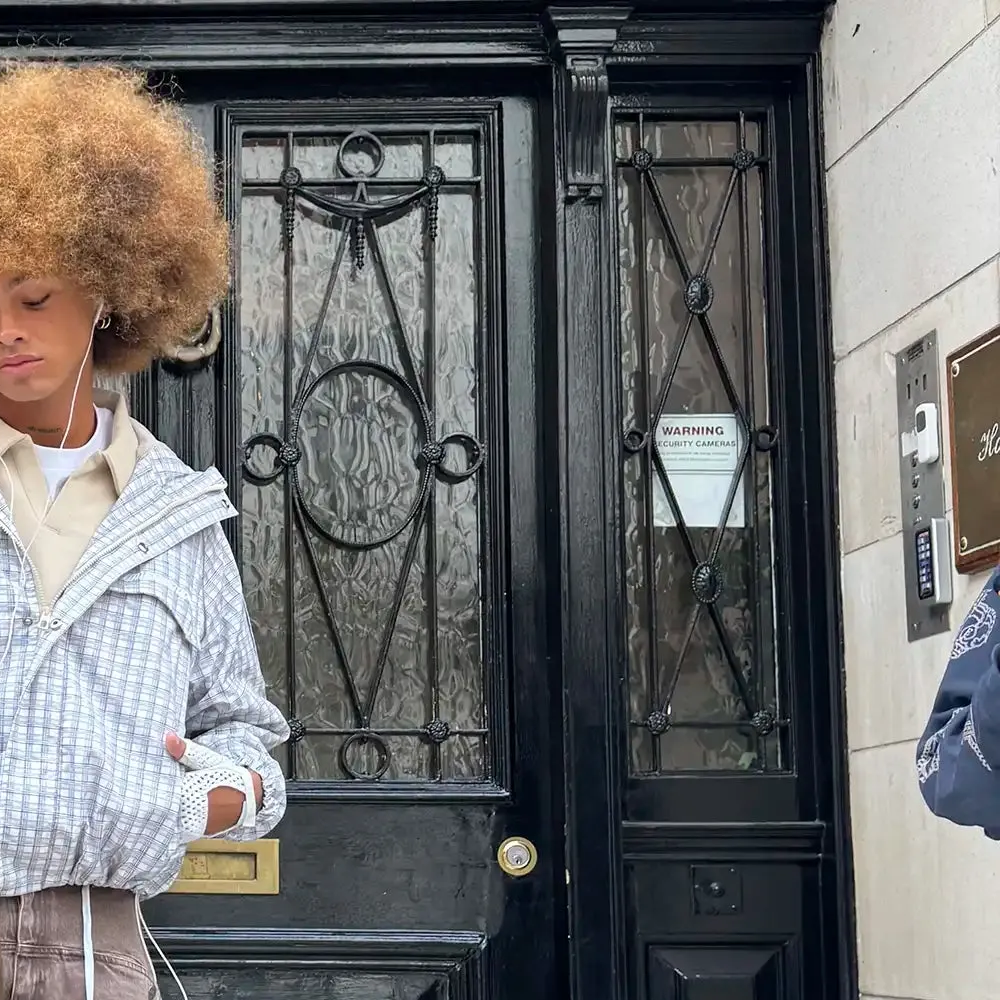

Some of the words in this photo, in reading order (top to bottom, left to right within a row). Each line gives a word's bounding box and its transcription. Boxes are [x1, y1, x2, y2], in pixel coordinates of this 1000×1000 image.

[661, 425, 725, 436] WARNING
[657, 440, 694, 448] ECURITY
[695, 440, 737, 448] CAMERAS
